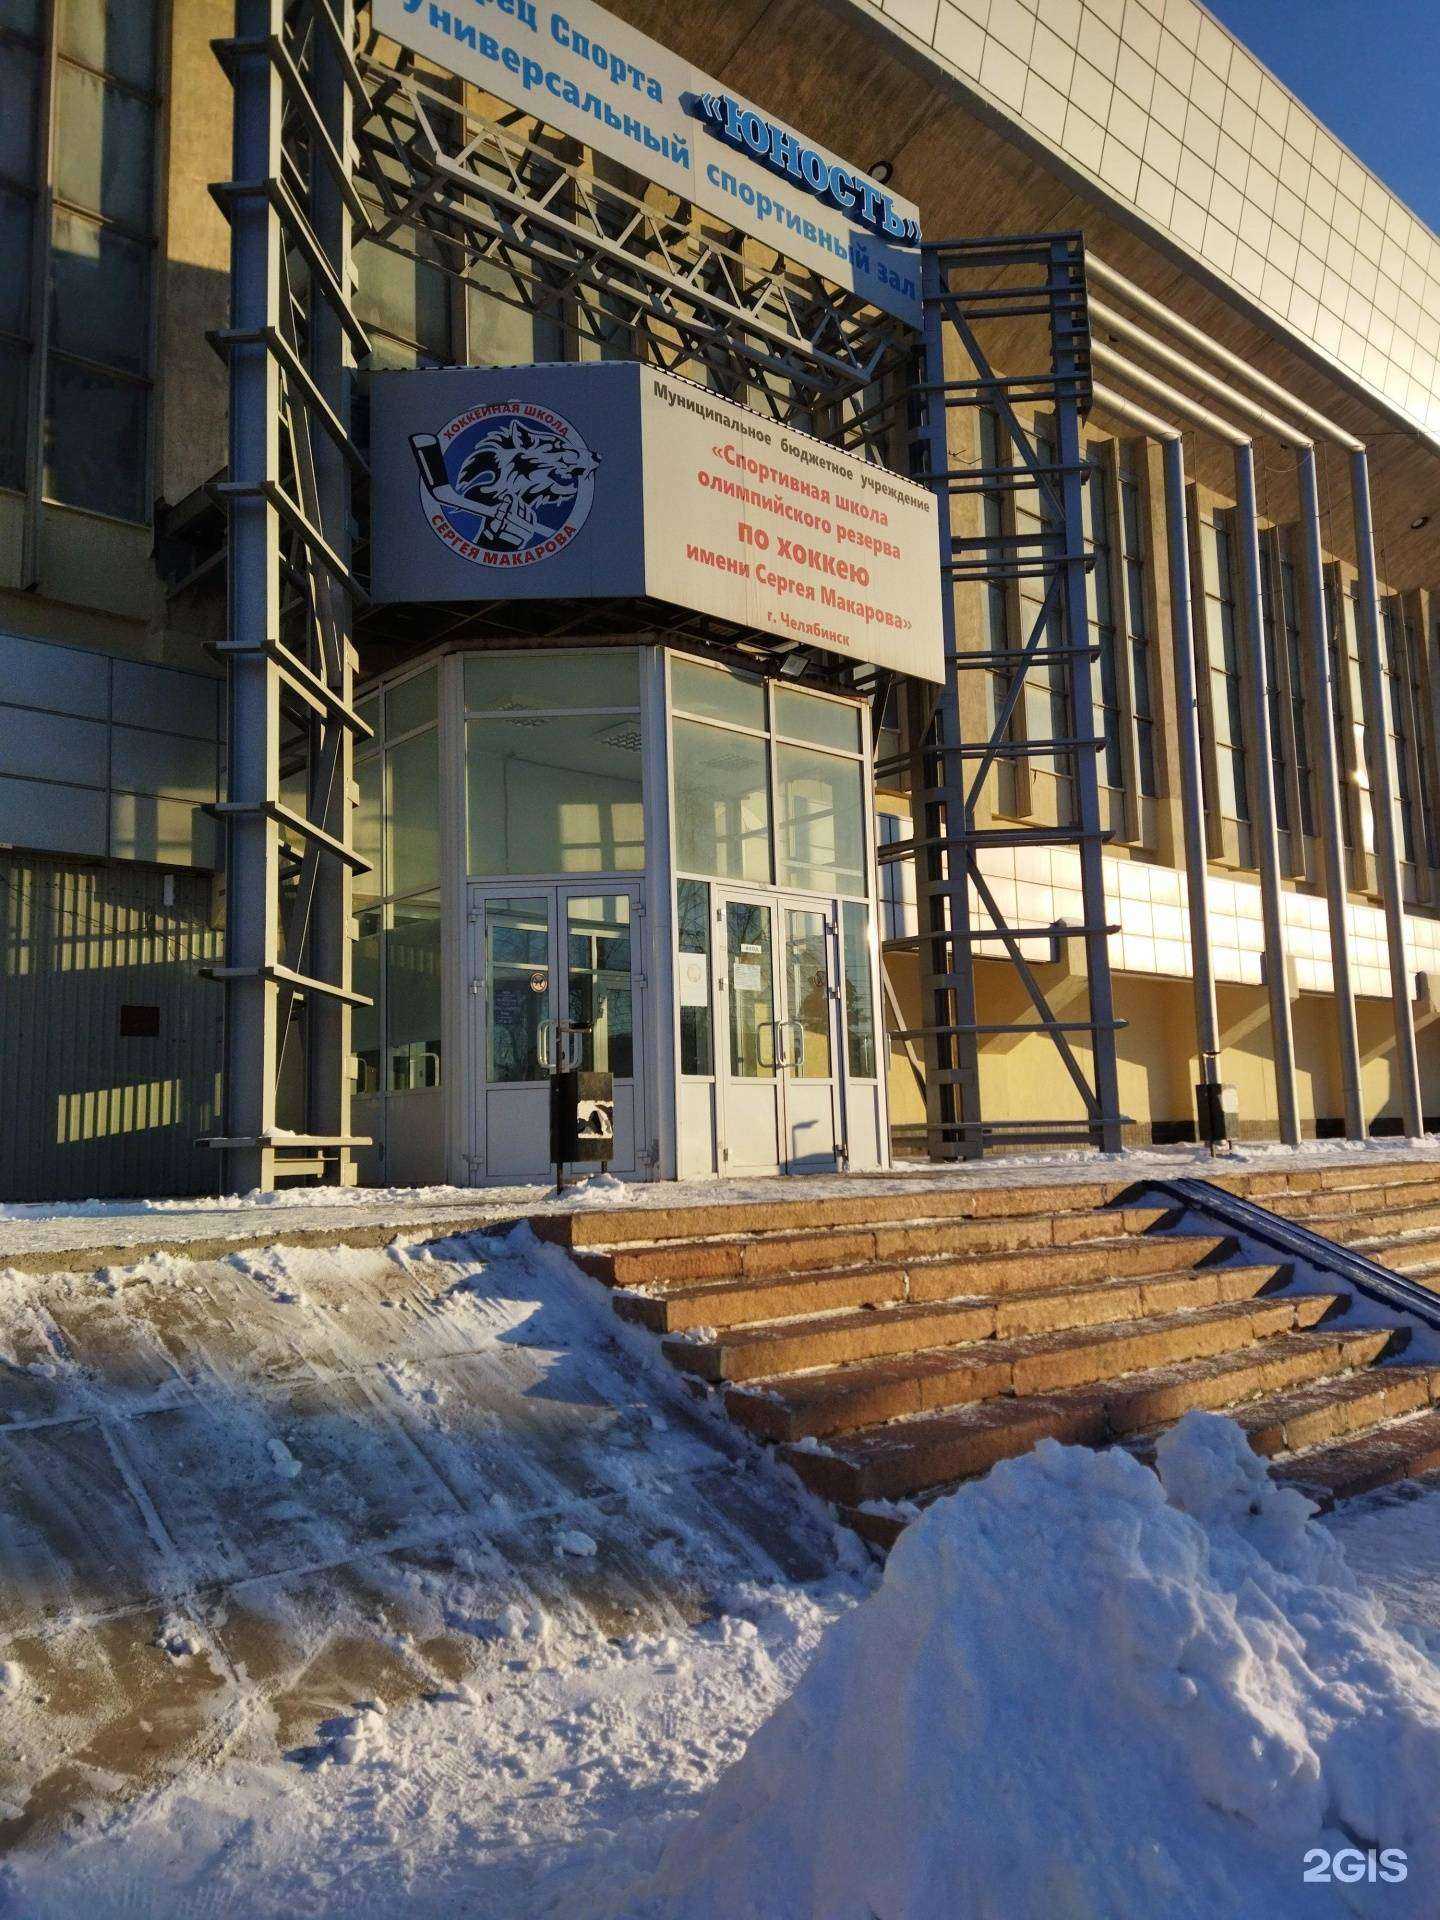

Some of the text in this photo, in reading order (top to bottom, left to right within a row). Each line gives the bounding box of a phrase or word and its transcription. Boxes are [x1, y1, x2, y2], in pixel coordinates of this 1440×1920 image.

[550, 13, 663, 104] Спорта
[701, 92, 923, 241] «ЮНОСТЬ»
[706, 163, 870, 274] спортивный
[876, 261, 917, 300] зал
[523, 403, 569, 438] ШКОЛА
[653, 381, 930, 513] Муниципальное бюджетное учреждение
[697, 469, 901, 560] олимпийского резерва
[711, 444, 889, 527] «Спортивная школа
[431, 514, 577, 566] СЕРГЕЯ МАКАРОВА
[777, 536, 870, 588] хоккею
[686, 543, 913, 631] имени Сергея Макарова»
[767, 611, 850, 648] г. Челябинск
